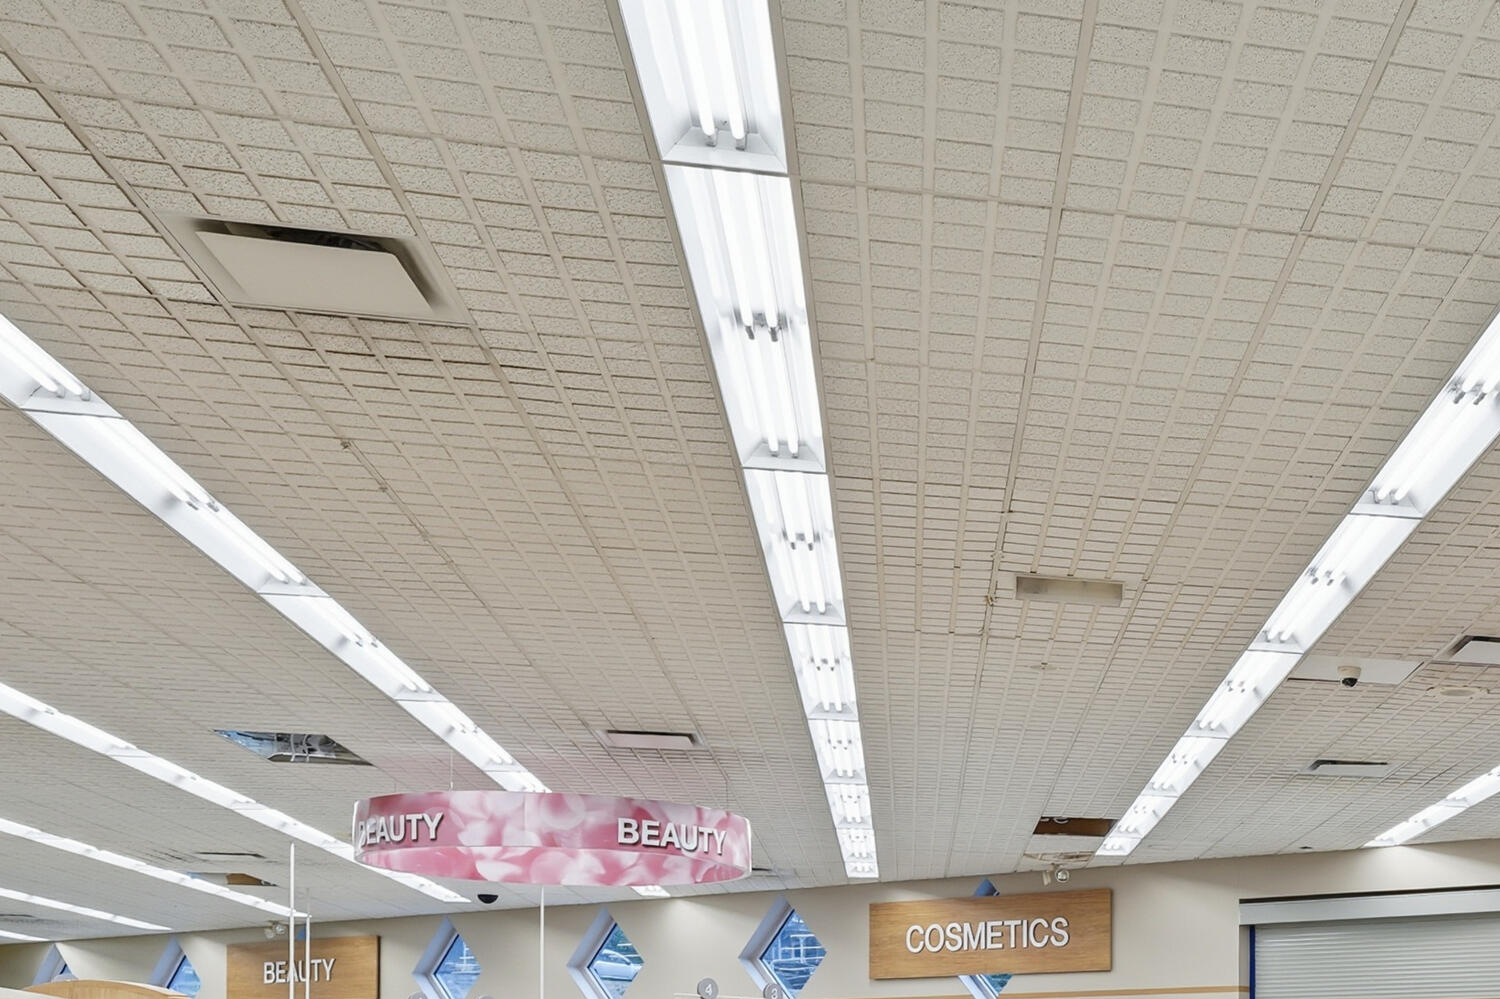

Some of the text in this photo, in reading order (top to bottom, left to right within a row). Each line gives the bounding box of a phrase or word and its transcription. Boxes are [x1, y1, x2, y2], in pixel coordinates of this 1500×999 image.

[359, 812, 444, 848] BEAUTY
[617, 817, 728, 855] BEAUTY
[905, 917, 1070, 953] COSMETICS
[263, 958, 336, 984] BEAUTY
[704, 984, 713, 996] 4
